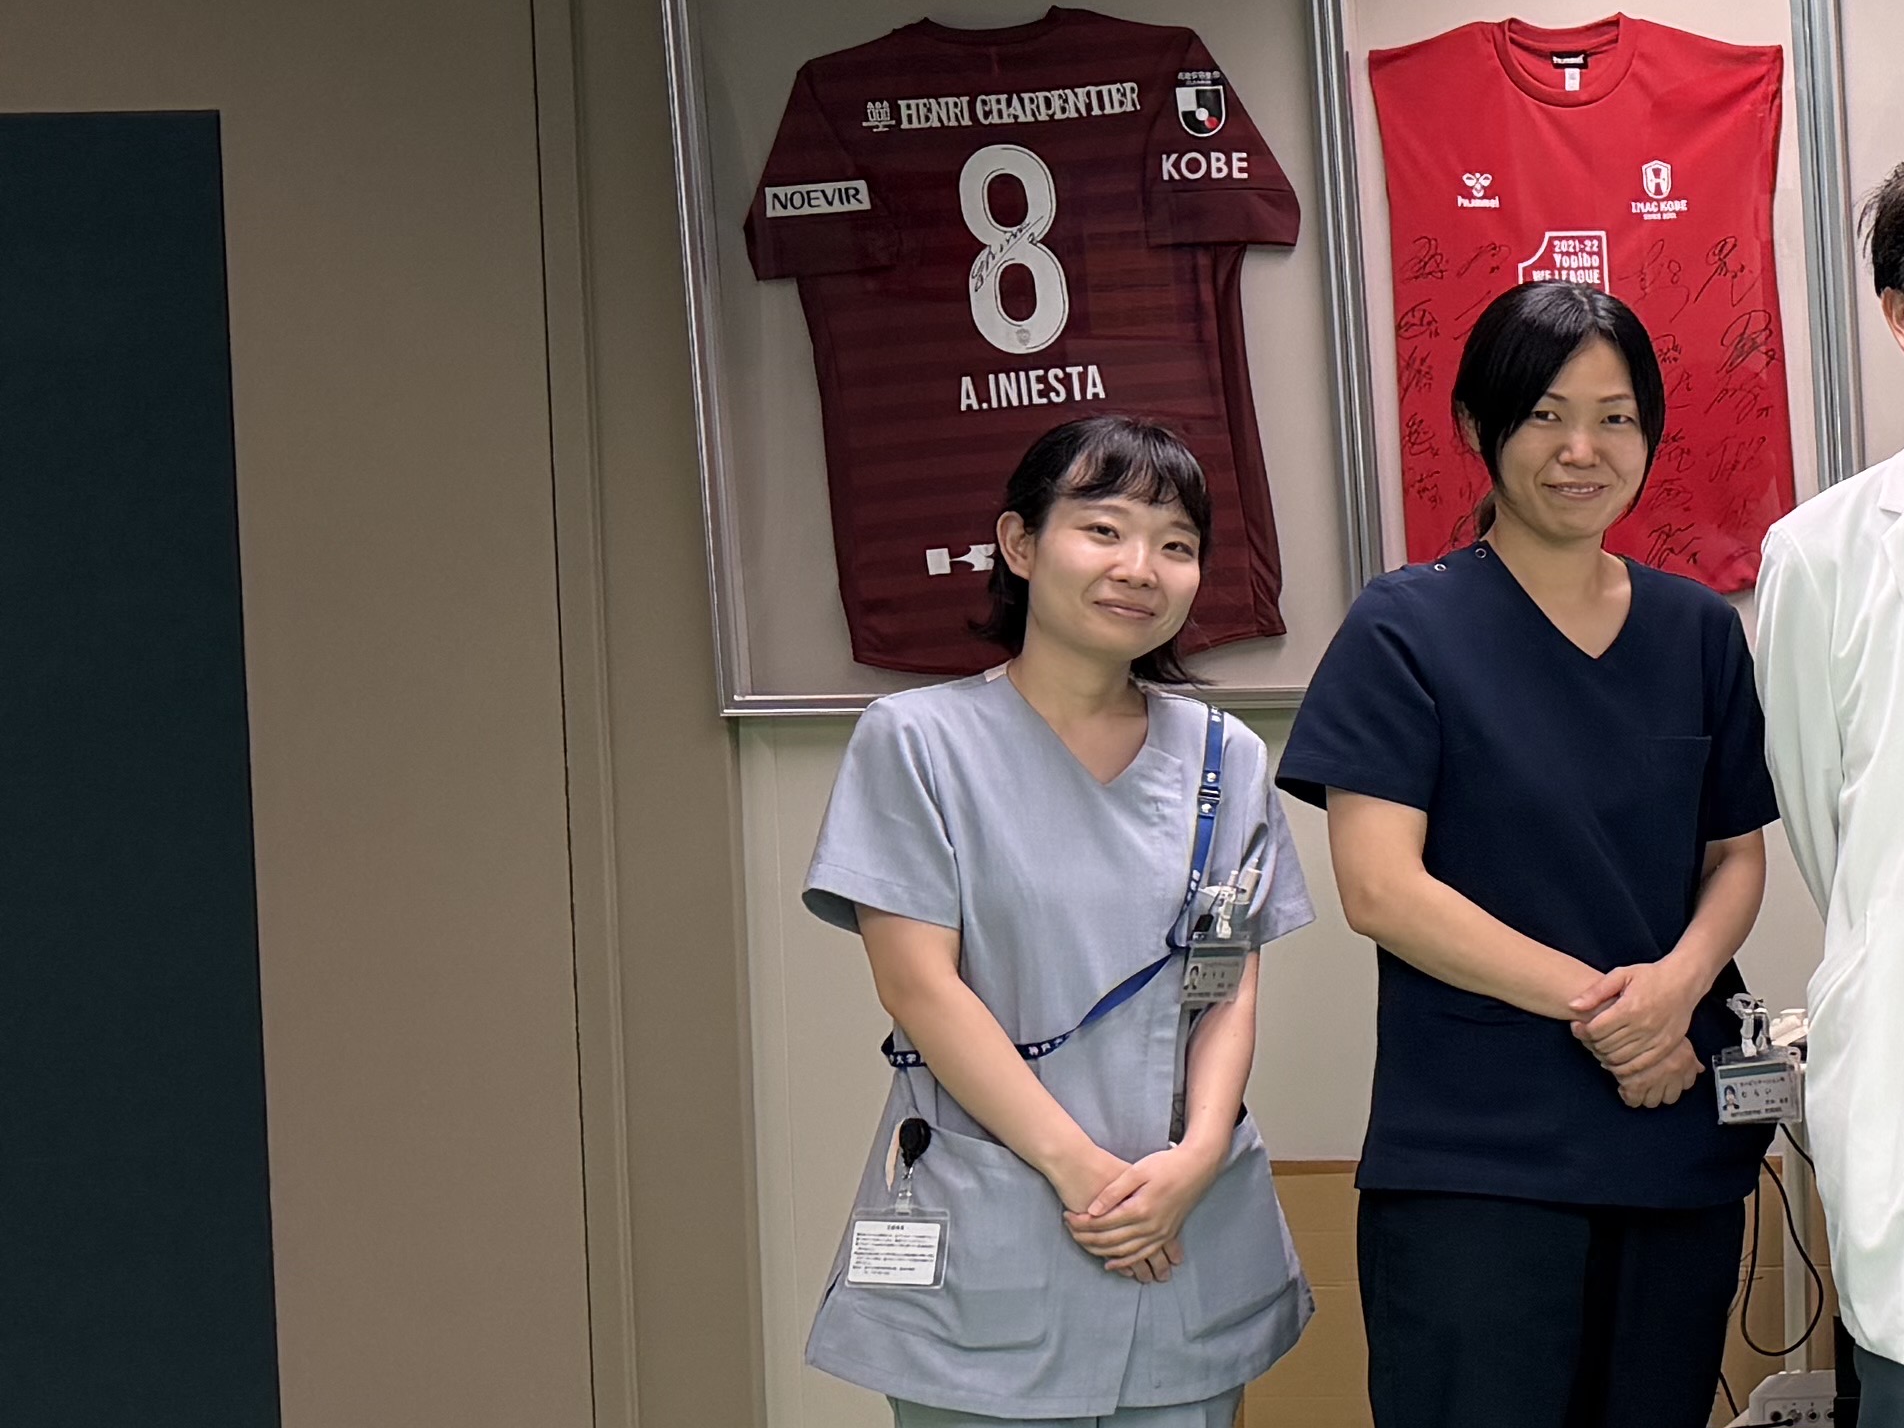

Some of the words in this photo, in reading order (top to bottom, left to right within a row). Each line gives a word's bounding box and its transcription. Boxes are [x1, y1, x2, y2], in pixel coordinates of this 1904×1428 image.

[899, 96, 973, 130] HENRI
[975, 82, 1141, 125] CHARPENTIER
[1161, 151, 1250, 181] KOBE
[771, 185, 865, 211] NOEVIR
[959, 143, 1069, 355] 8
[1552, 252, 1600, 269] Yogibo
[1553, 239, 1599, 253] 2021-22
[959, 364, 1106, 412] A.INIESTA
